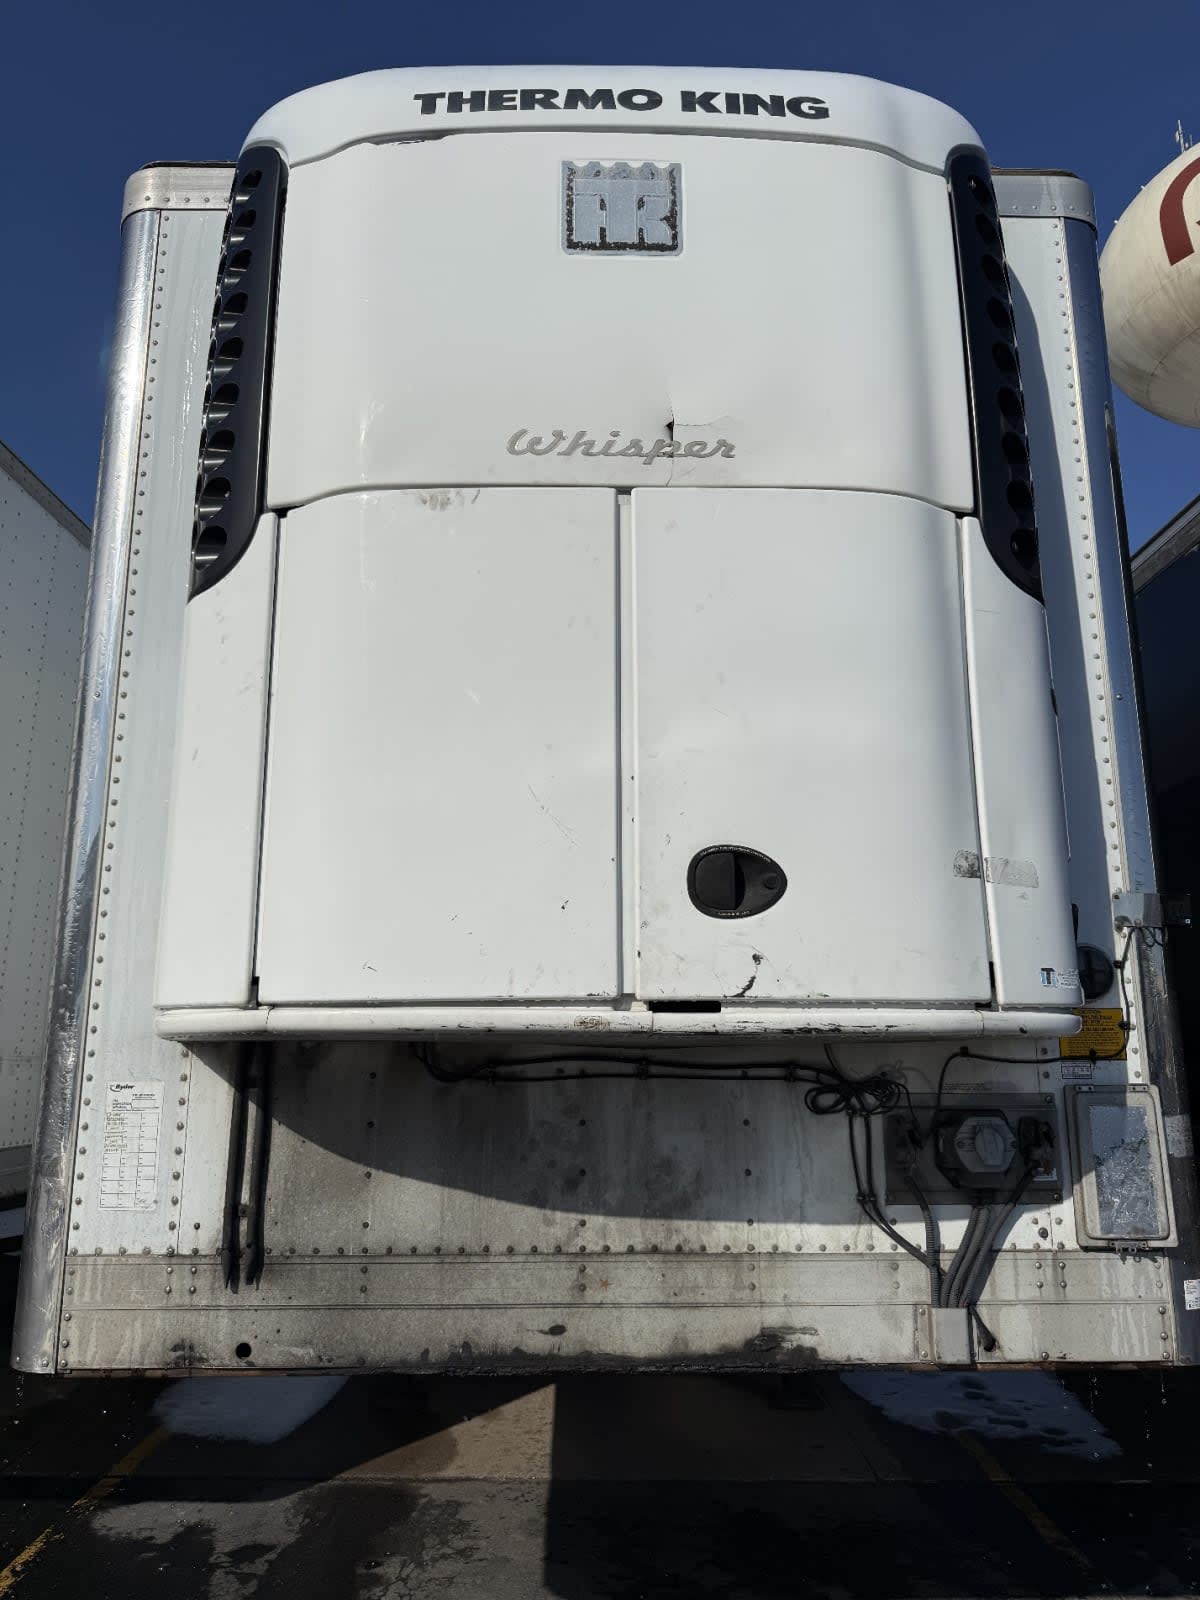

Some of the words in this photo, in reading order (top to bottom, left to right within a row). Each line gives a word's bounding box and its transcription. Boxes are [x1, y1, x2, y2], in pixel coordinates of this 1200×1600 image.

[413, 88, 663, 116] THERMO
[680, 90, 831, 120] KING
[505, 427, 737, 465] Whisper
